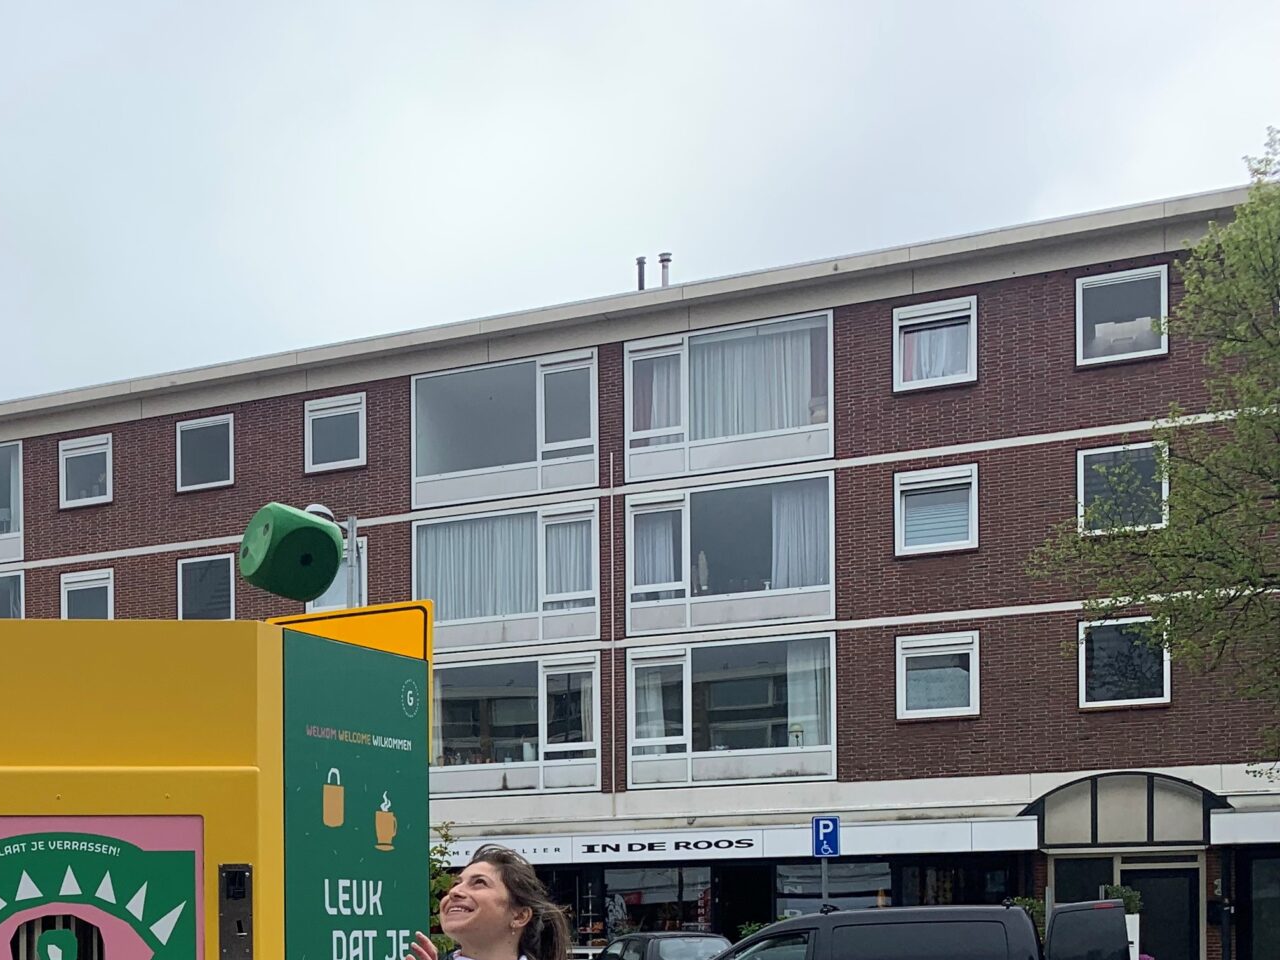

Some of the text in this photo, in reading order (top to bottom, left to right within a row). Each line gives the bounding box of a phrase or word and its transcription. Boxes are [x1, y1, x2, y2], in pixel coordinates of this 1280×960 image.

[305, 724, 412, 752] WELKOM WELCOME WILKOMMEN
[819, 820, 833, 841] P
[31, 841, 45, 851] JE
[48, 840, 120, 857] VERRASSEN!
[581, 844, 620, 854] IN
[627, 842, 666, 852] DE
[674, 838, 754, 851] ROOS
[324, 878, 383, 916] LEUK
